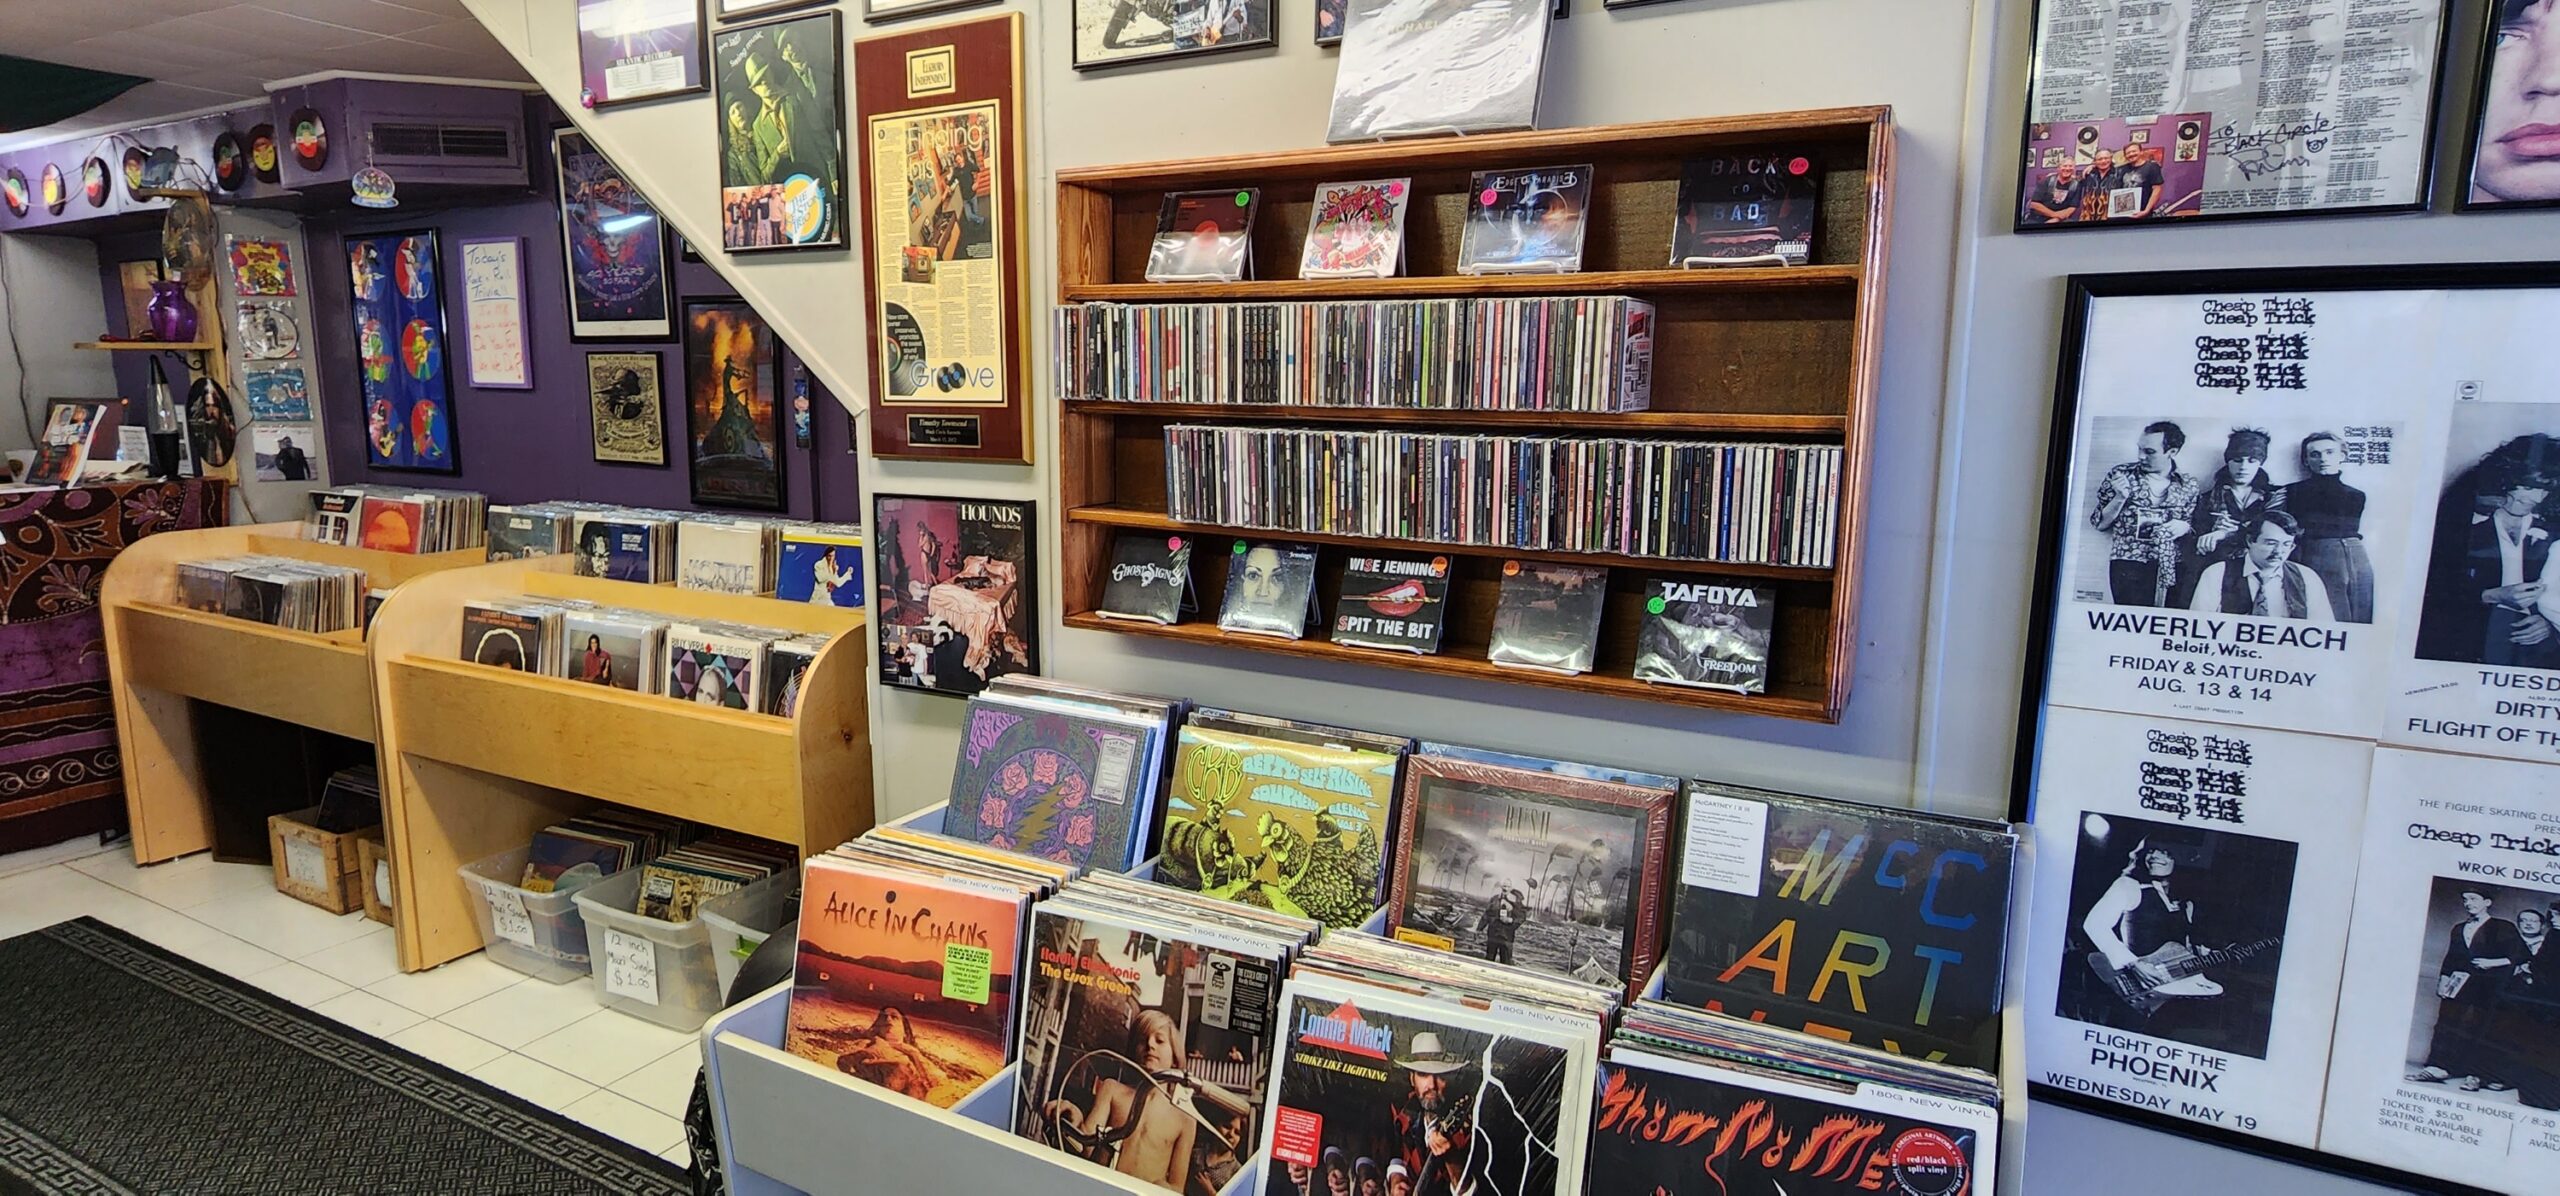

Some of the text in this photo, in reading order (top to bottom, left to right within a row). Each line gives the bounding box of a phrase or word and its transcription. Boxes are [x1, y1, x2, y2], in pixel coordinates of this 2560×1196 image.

[2202, 297, 2314, 315] Cheap Trick
[2204, 311, 2316, 327] Cheap Trick
[2195, 336, 2250, 350] Cheap
[2194, 362, 2248, 377] Cheap
[2196, 375, 2250, 394] Cheap
[961, 504, 1021, 523] HOUNDS
[1350, 557, 1446, 578] WISE JENNINGS
[1661, 582, 1758, 608] TAFOYA
[1337, 616, 1434, 640] SPIT THE BIT
[2087, 610, 2348, 652] WAVERLY BEACH
[1704, 660, 1757, 674] FREEDOM
[2109, 655, 2317, 687] FRIDAY & SATURDAY
[2137, 676, 2273, 702] AUG. 13 & 14
[2147, 729, 2251, 753] Cheap Trick
[2408, 718, 2492, 739] FLIGHT
[2496, 726, 2530, 742] OF
[2148, 741, 2253, 765] Cheap Trick
[2419, 799, 2441, 809] THE
[2444, 802, 2485, 814] FIGURE
[2489, 807, 2537, 820] SKATING
[2408, 823, 2560, 857] Cheap Trick
[2458, 861, 2508, 878] WROK
[970, 880, 990, 889] NEW
[992, 884, 1015, 894] VINYL
[824, 891, 878, 928] ALICE
[911, 907, 988, 948] CHAINS
[610, 933, 621, 946] 12
[1218, 932, 1241, 942] NEW
[1242, 937, 1271, 949] VINYL
[1040, 946, 1077, 967] Hardly
[1040, 962, 1062, 979] The
[1096, 977, 1132, 996] Green
[1716, 917, 1966, 1026] ART
[1498, 1004, 1593, 1029] 180G NEW VINYL
[1298, 1006, 1348, 1042] Lonnie
[1349, 1017, 1394, 1054] Mack
[2084, 1029, 2228, 1072] FLIGHT OF THE
[1294, 1052, 1388, 1083] STRIKE LIKE LIGHTNING
[2090, 1048, 2220, 1093] PHOENIX
[1869, 1088, 1992, 1119] 180G NEW VINYL
[2046, 1071, 2171, 1110] WEDNESDAY
[2181, 1102, 2225, 1123] MAY
[2235, 1114, 2257, 1130] 19
[2381, 1098, 2464, 1122] TICKETS $5.00
[2396, 1089, 2453, 1107] RIVERVIEW
[2456, 1101, 2472, 1111] ICE
[2477, 1105, 2515, 1121] HOUSE
[2378, 1117, 2409, 1131] SKATE
[2414, 1125, 2455, 1141] RENTAL
[2379, 1108, 2483, 1137] SEATING AVAILABLE
[1906, 1155, 1947, 1164] red/black
[1907, 1165, 1947, 1175] split vinyl
